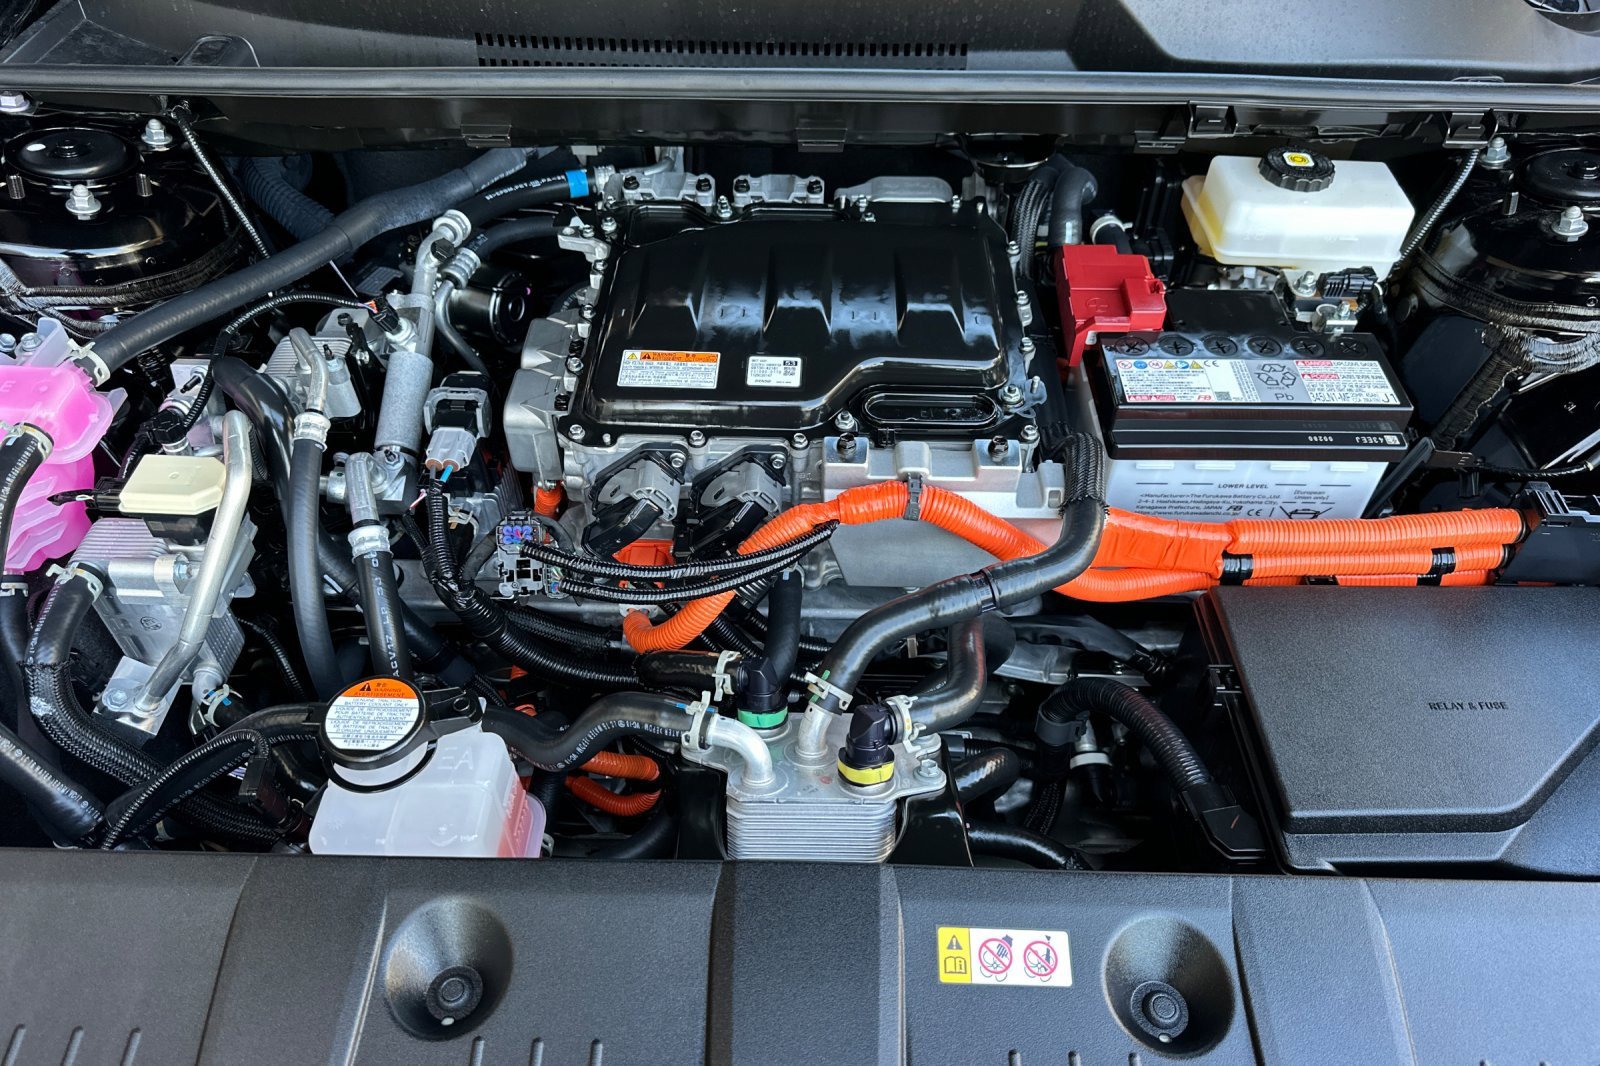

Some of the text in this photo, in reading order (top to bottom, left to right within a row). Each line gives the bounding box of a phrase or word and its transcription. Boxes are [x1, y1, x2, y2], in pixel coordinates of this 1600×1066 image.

[1275, 392, 1295, 401] Pb
[1247, 509, 1262, 517] CE
[1428, 702, 1509, 711] RELAY & FUSE
